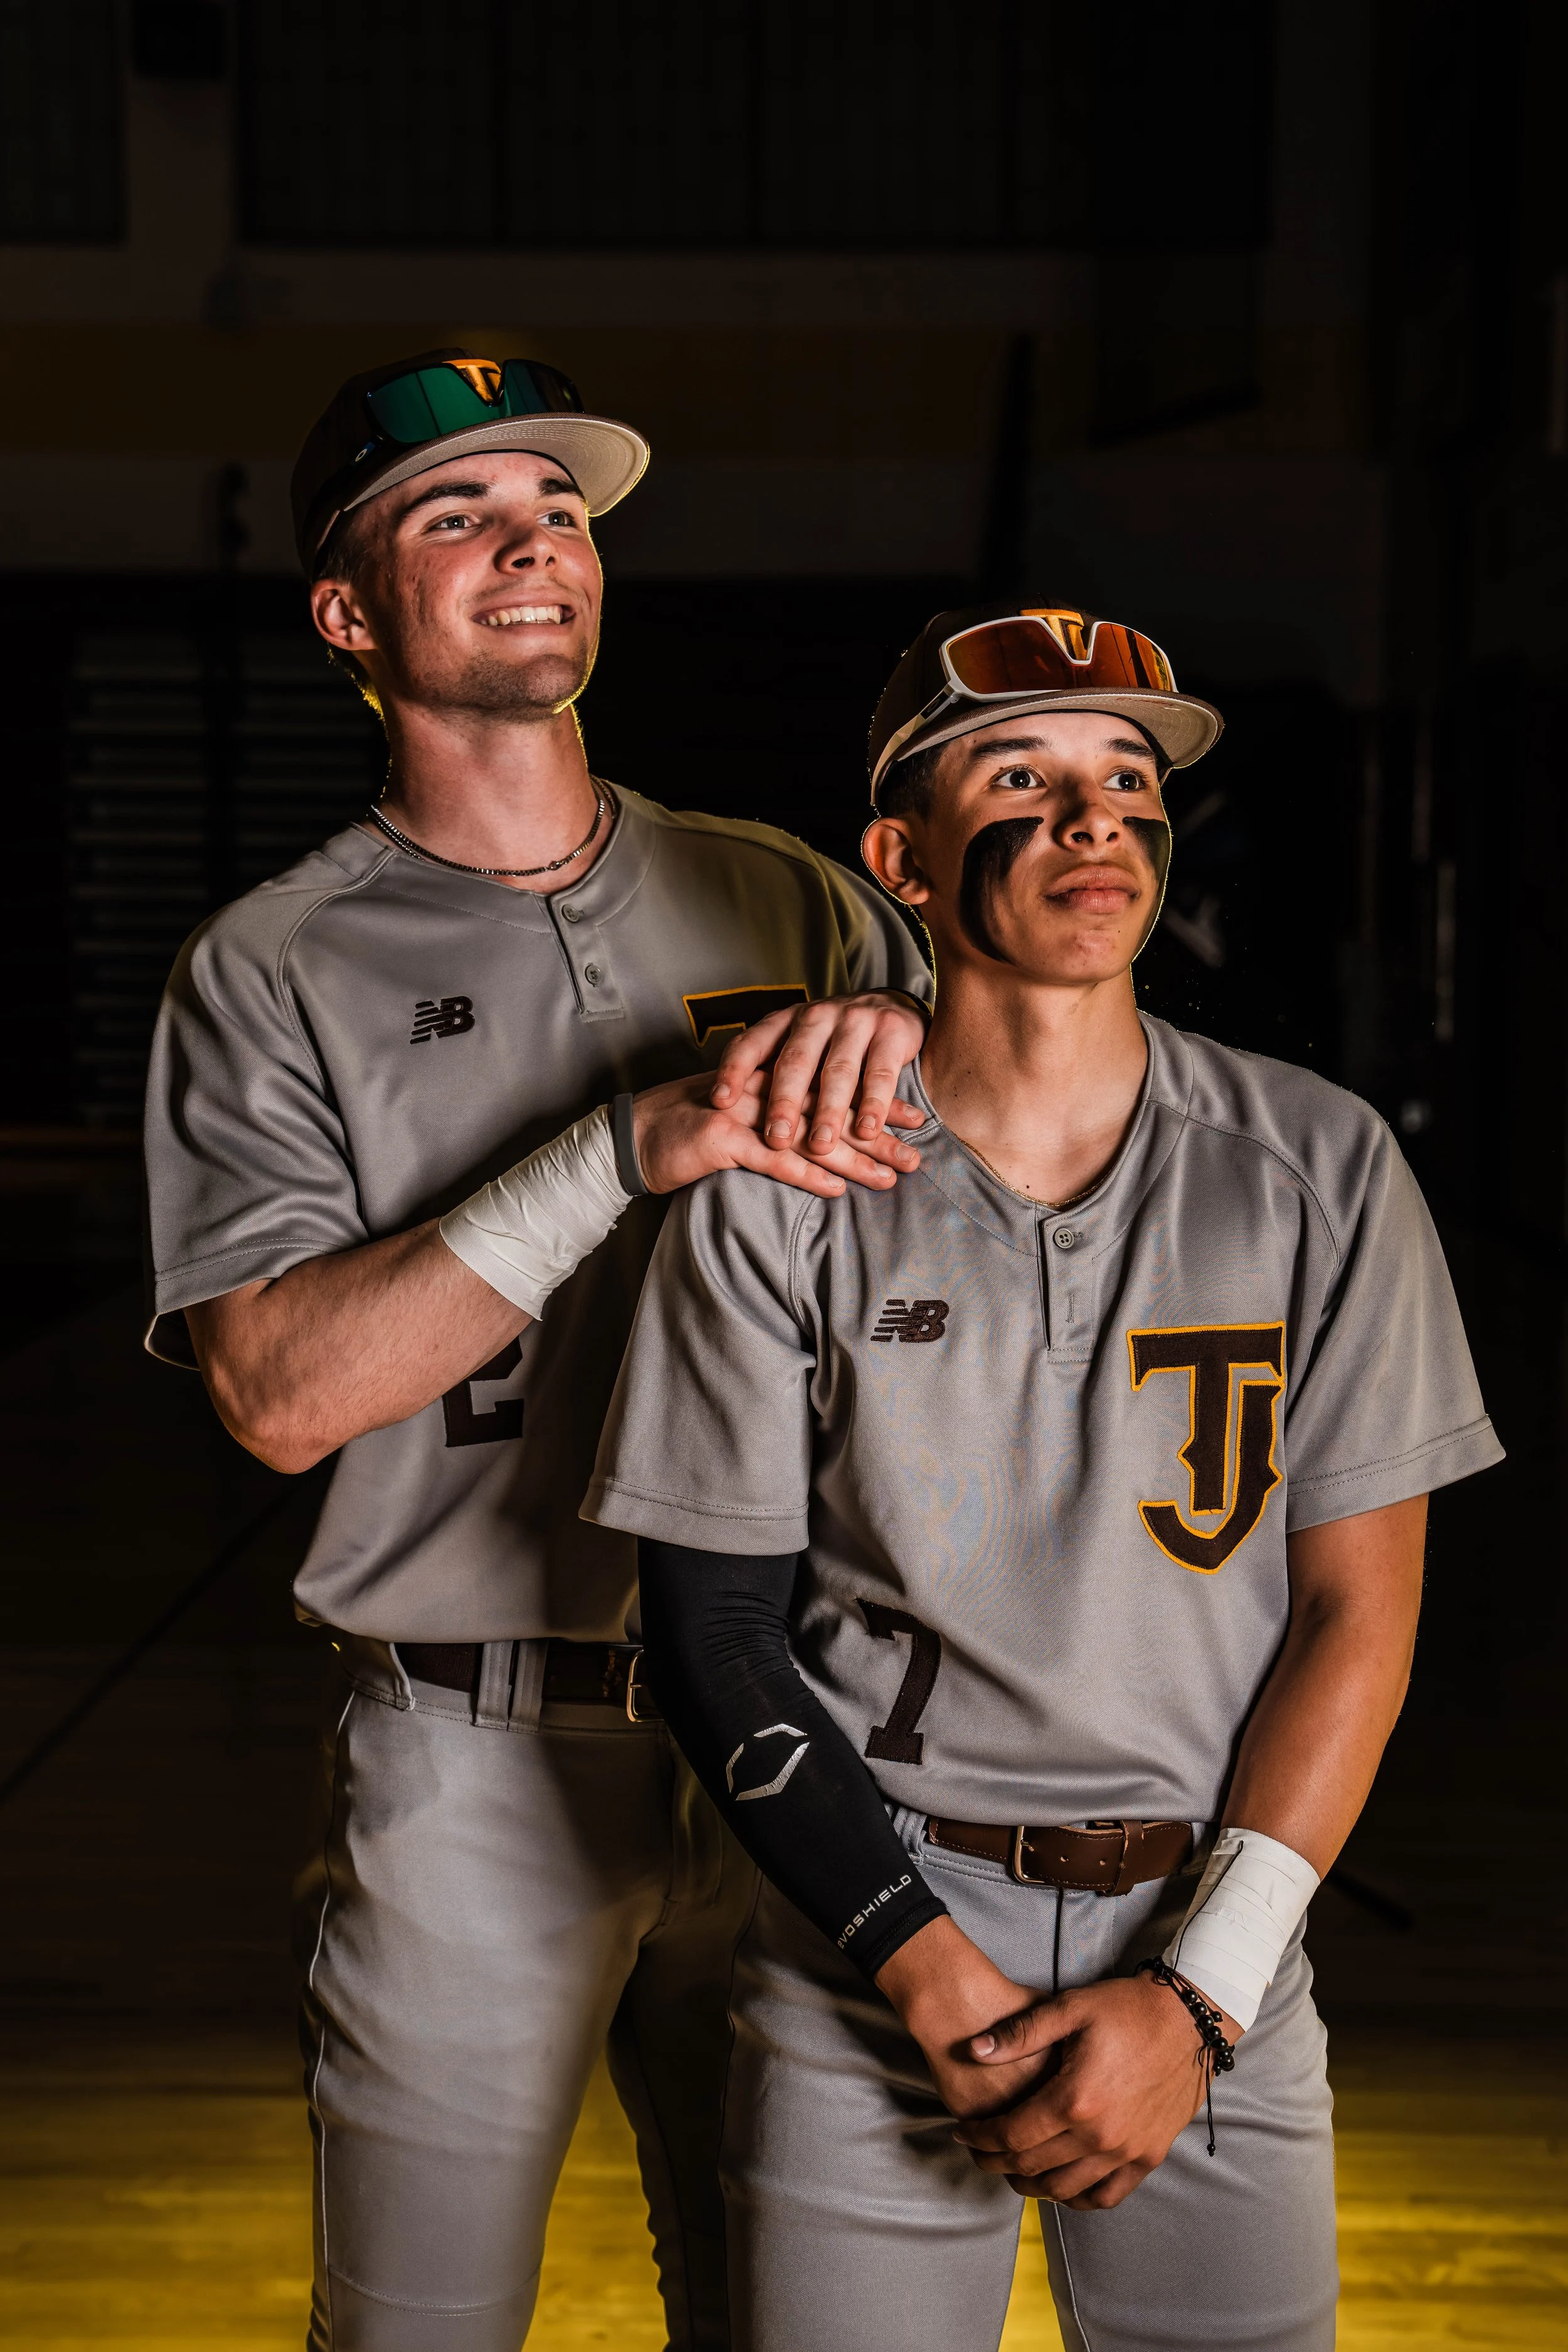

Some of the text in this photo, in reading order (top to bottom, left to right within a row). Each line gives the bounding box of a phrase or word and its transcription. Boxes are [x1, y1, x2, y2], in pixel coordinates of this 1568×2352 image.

[442, 358, 501, 402] T
[410, 995, 475, 1044] NB
[870, 1299, 949, 1343] NB
[1126, 1320, 1285, 1575] TJ
[854, 1597, 941, 1766] 7
